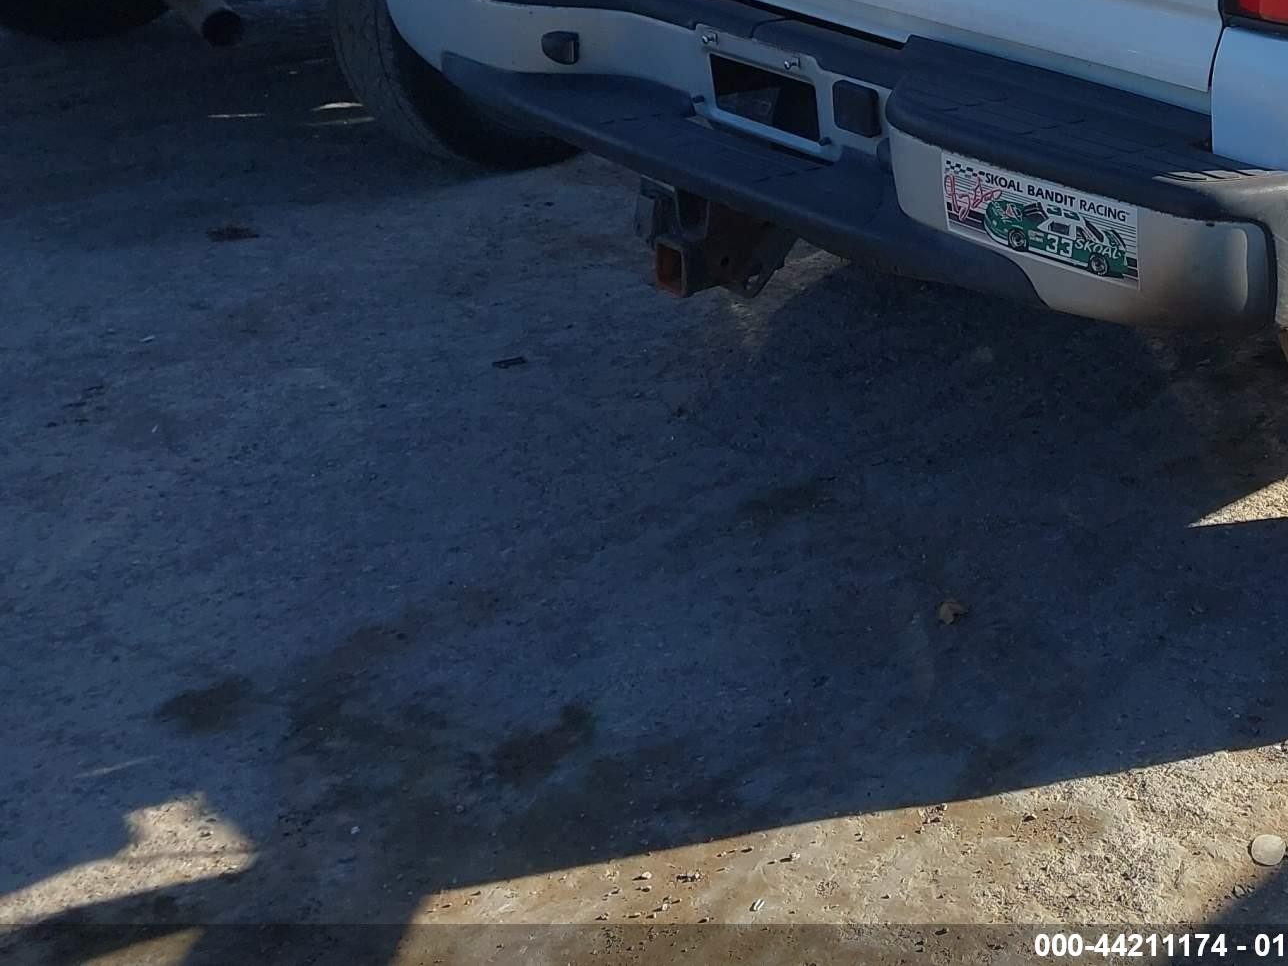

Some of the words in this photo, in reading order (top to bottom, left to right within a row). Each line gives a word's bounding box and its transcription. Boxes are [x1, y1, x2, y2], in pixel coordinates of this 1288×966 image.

[984, 172, 1023, 194] SKOAL
[1027, 185, 1076, 208] BANDIT
[1079, 199, 1127, 223] RACING
[1045, 234, 1074, 258] 33
[1074, 237, 1122, 260] SKOAL
